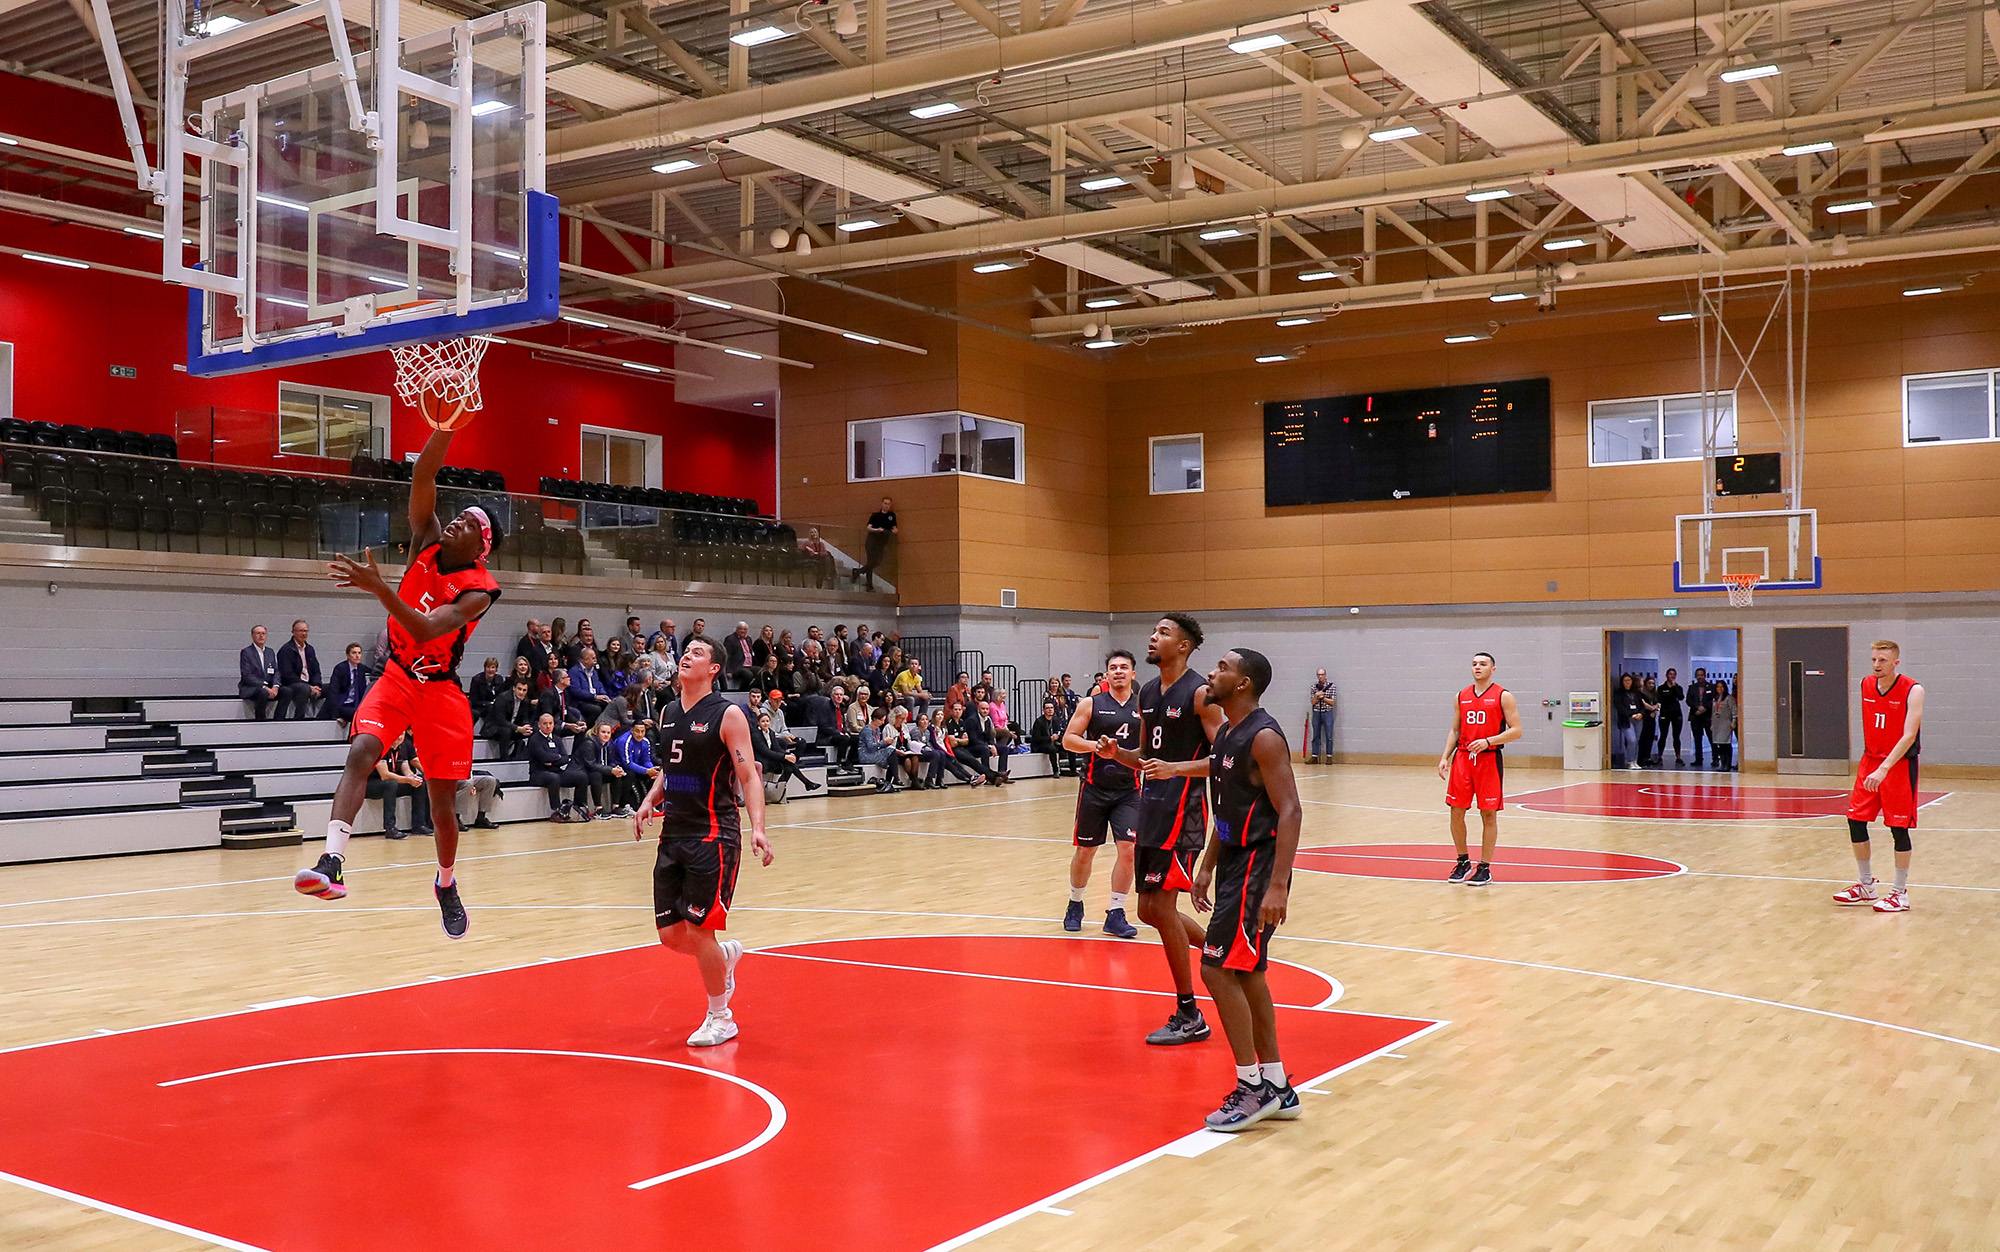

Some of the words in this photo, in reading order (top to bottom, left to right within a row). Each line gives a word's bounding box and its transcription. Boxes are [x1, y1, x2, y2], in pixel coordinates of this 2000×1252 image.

[1733, 457, 1745, 472] 2
[415, 591, 435, 616] 5
[1466, 710, 1486, 725] 80
[1874, 712, 1886, 729] 11
[1115, 722, 1130, 740] 4
[1152, 725, 1163, 750] 8
[669, 739, 684, 764] 5
